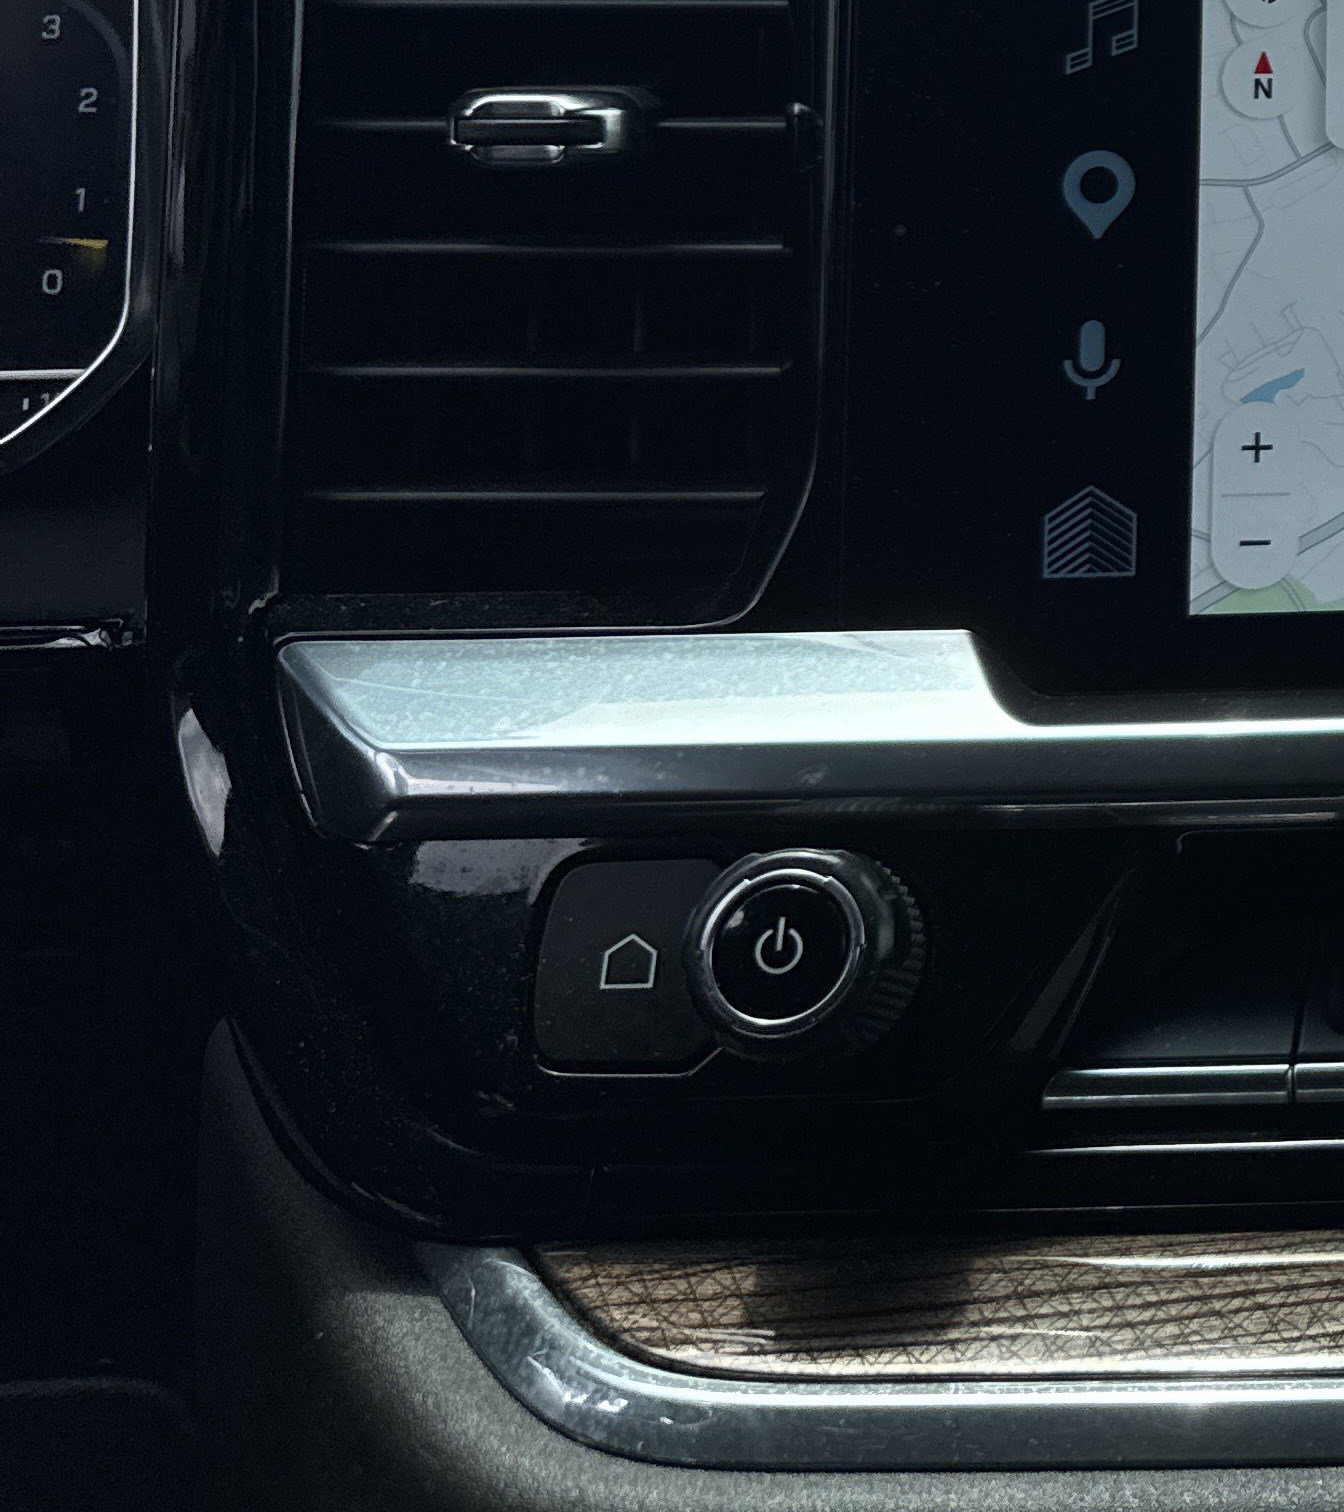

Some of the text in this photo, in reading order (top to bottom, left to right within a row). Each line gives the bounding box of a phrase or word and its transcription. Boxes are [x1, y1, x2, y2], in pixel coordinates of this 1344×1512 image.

[41, 14, 62, 41] 3
[77, 86, 99, 114] 2
[1253, 77, 1273, 100] N
[75, 187, 86, 213] 1
[41, 268, 63, 296] 0
